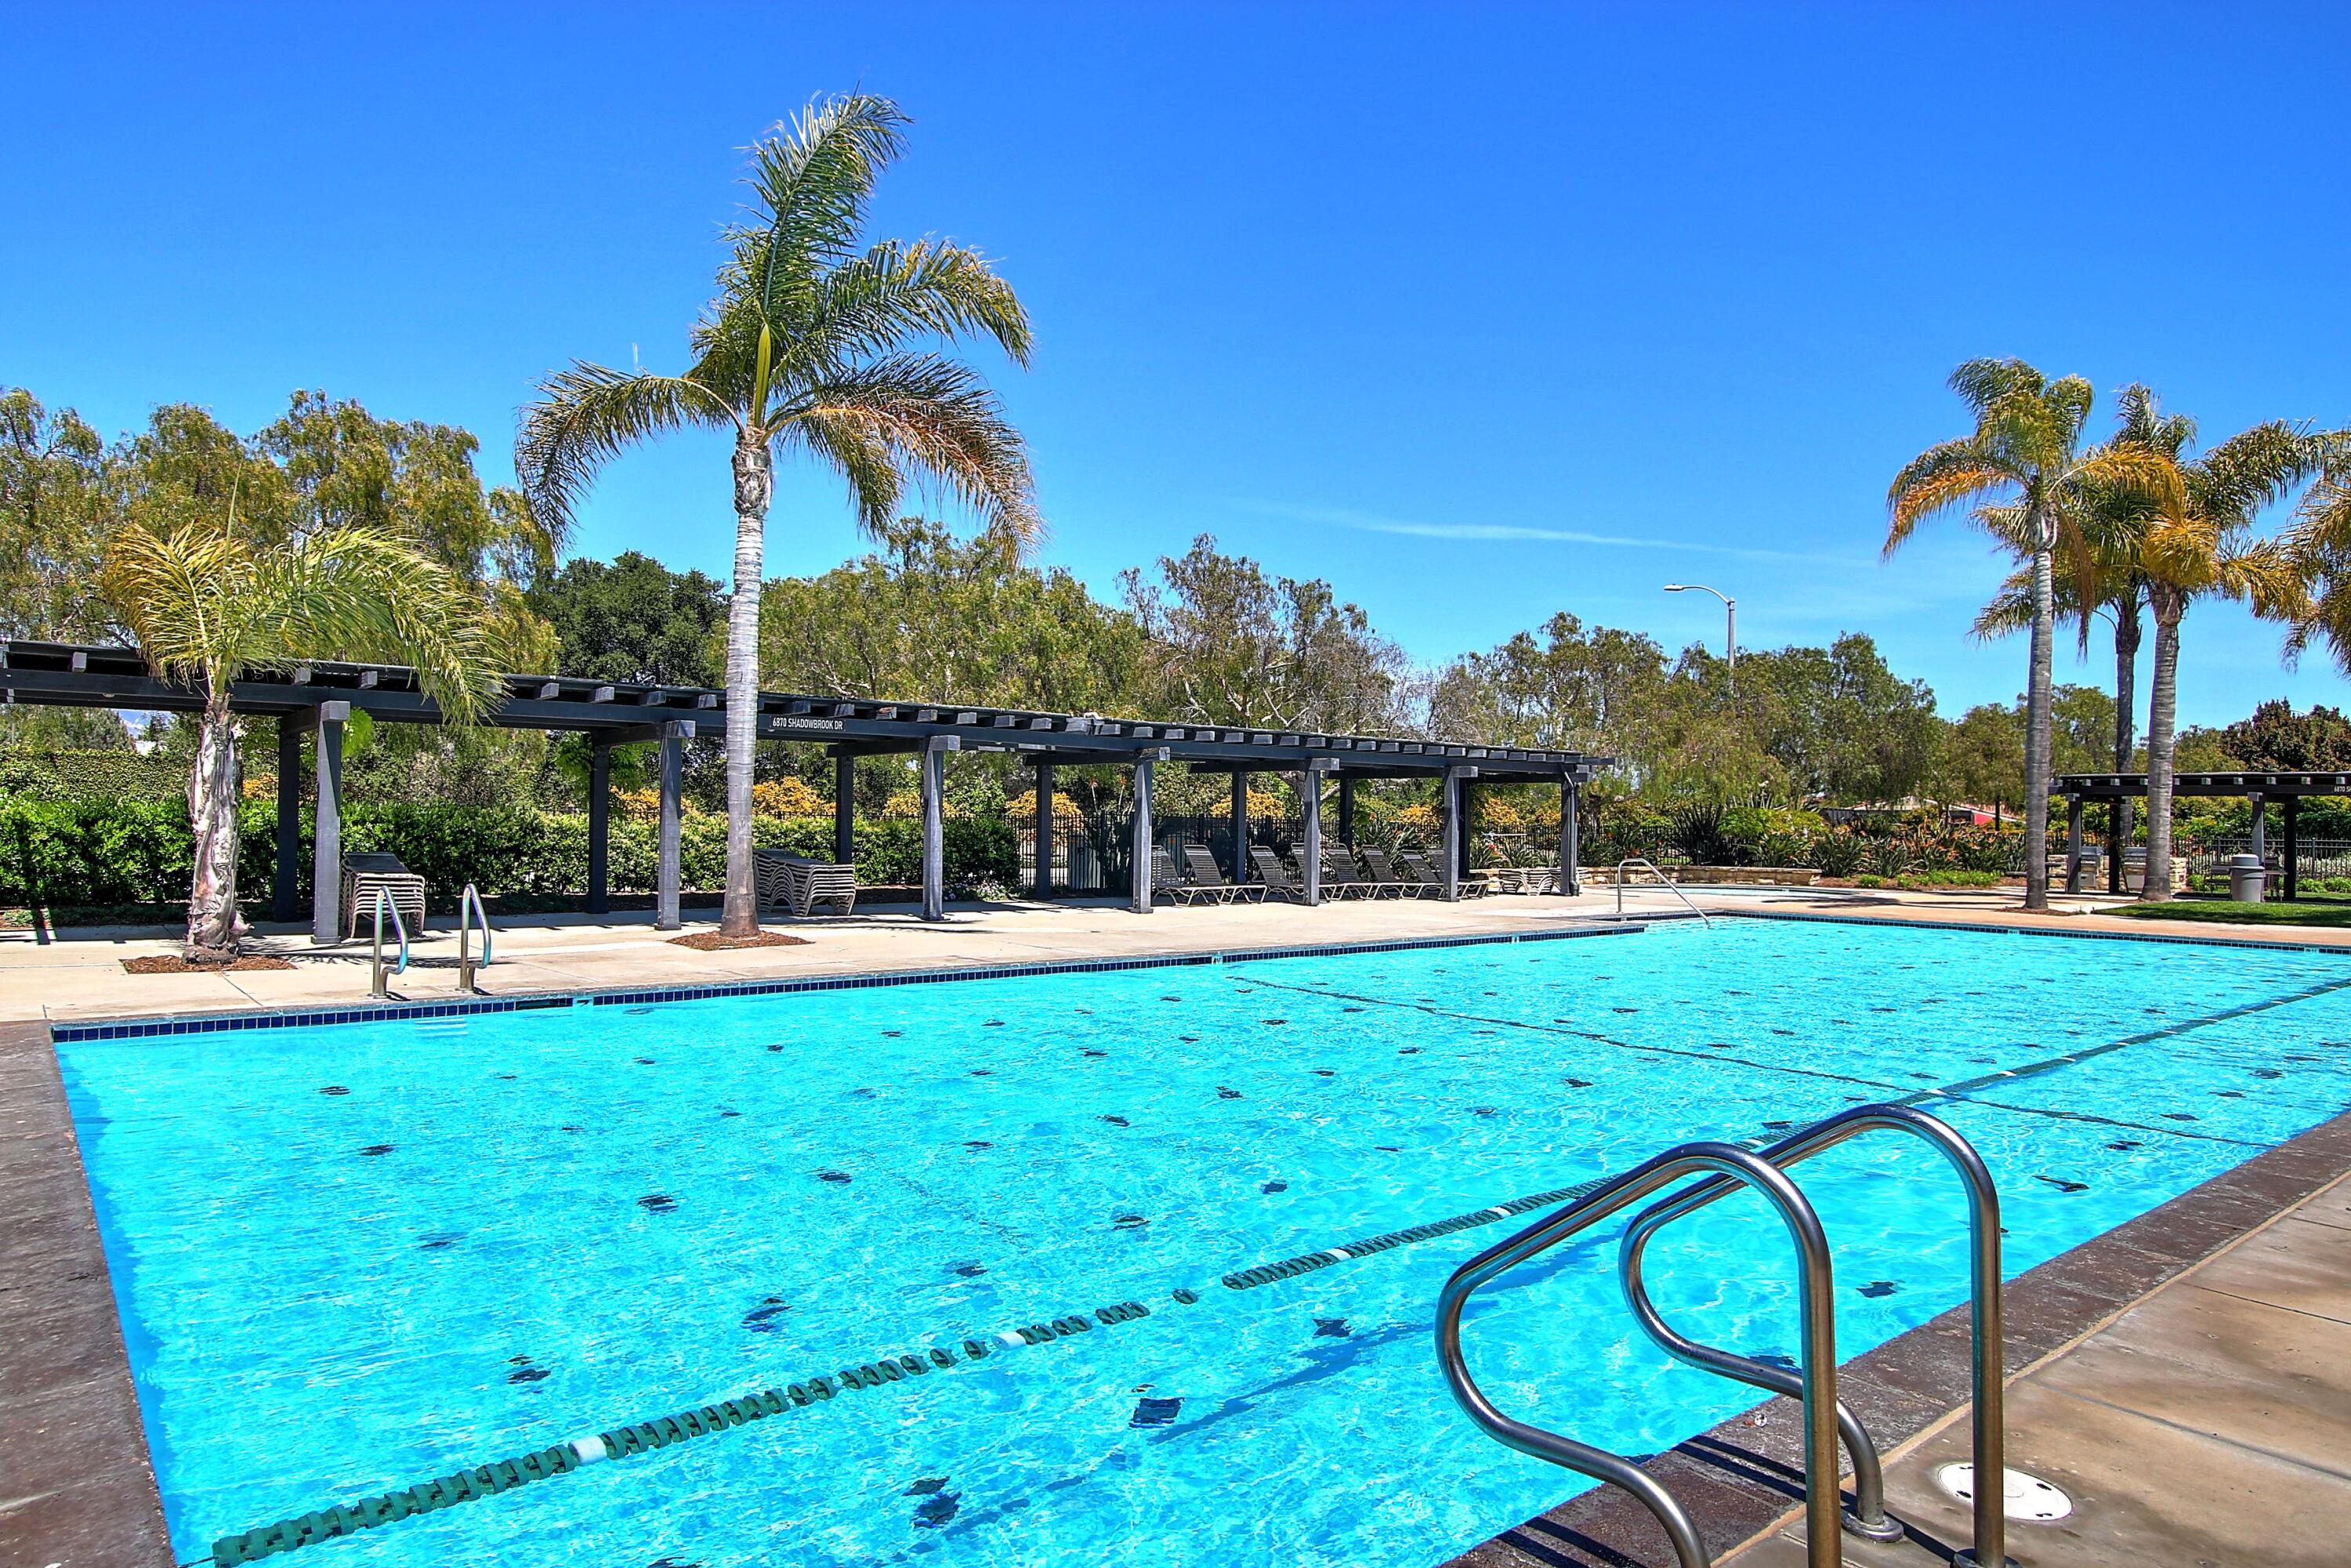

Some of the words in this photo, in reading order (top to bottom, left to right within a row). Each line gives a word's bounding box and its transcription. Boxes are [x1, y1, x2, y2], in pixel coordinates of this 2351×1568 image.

[772, 717, 787, 727] 6870
[788, 718, 834, 730] SHADOWBROOK
[834, 720, 843, 730] DR
